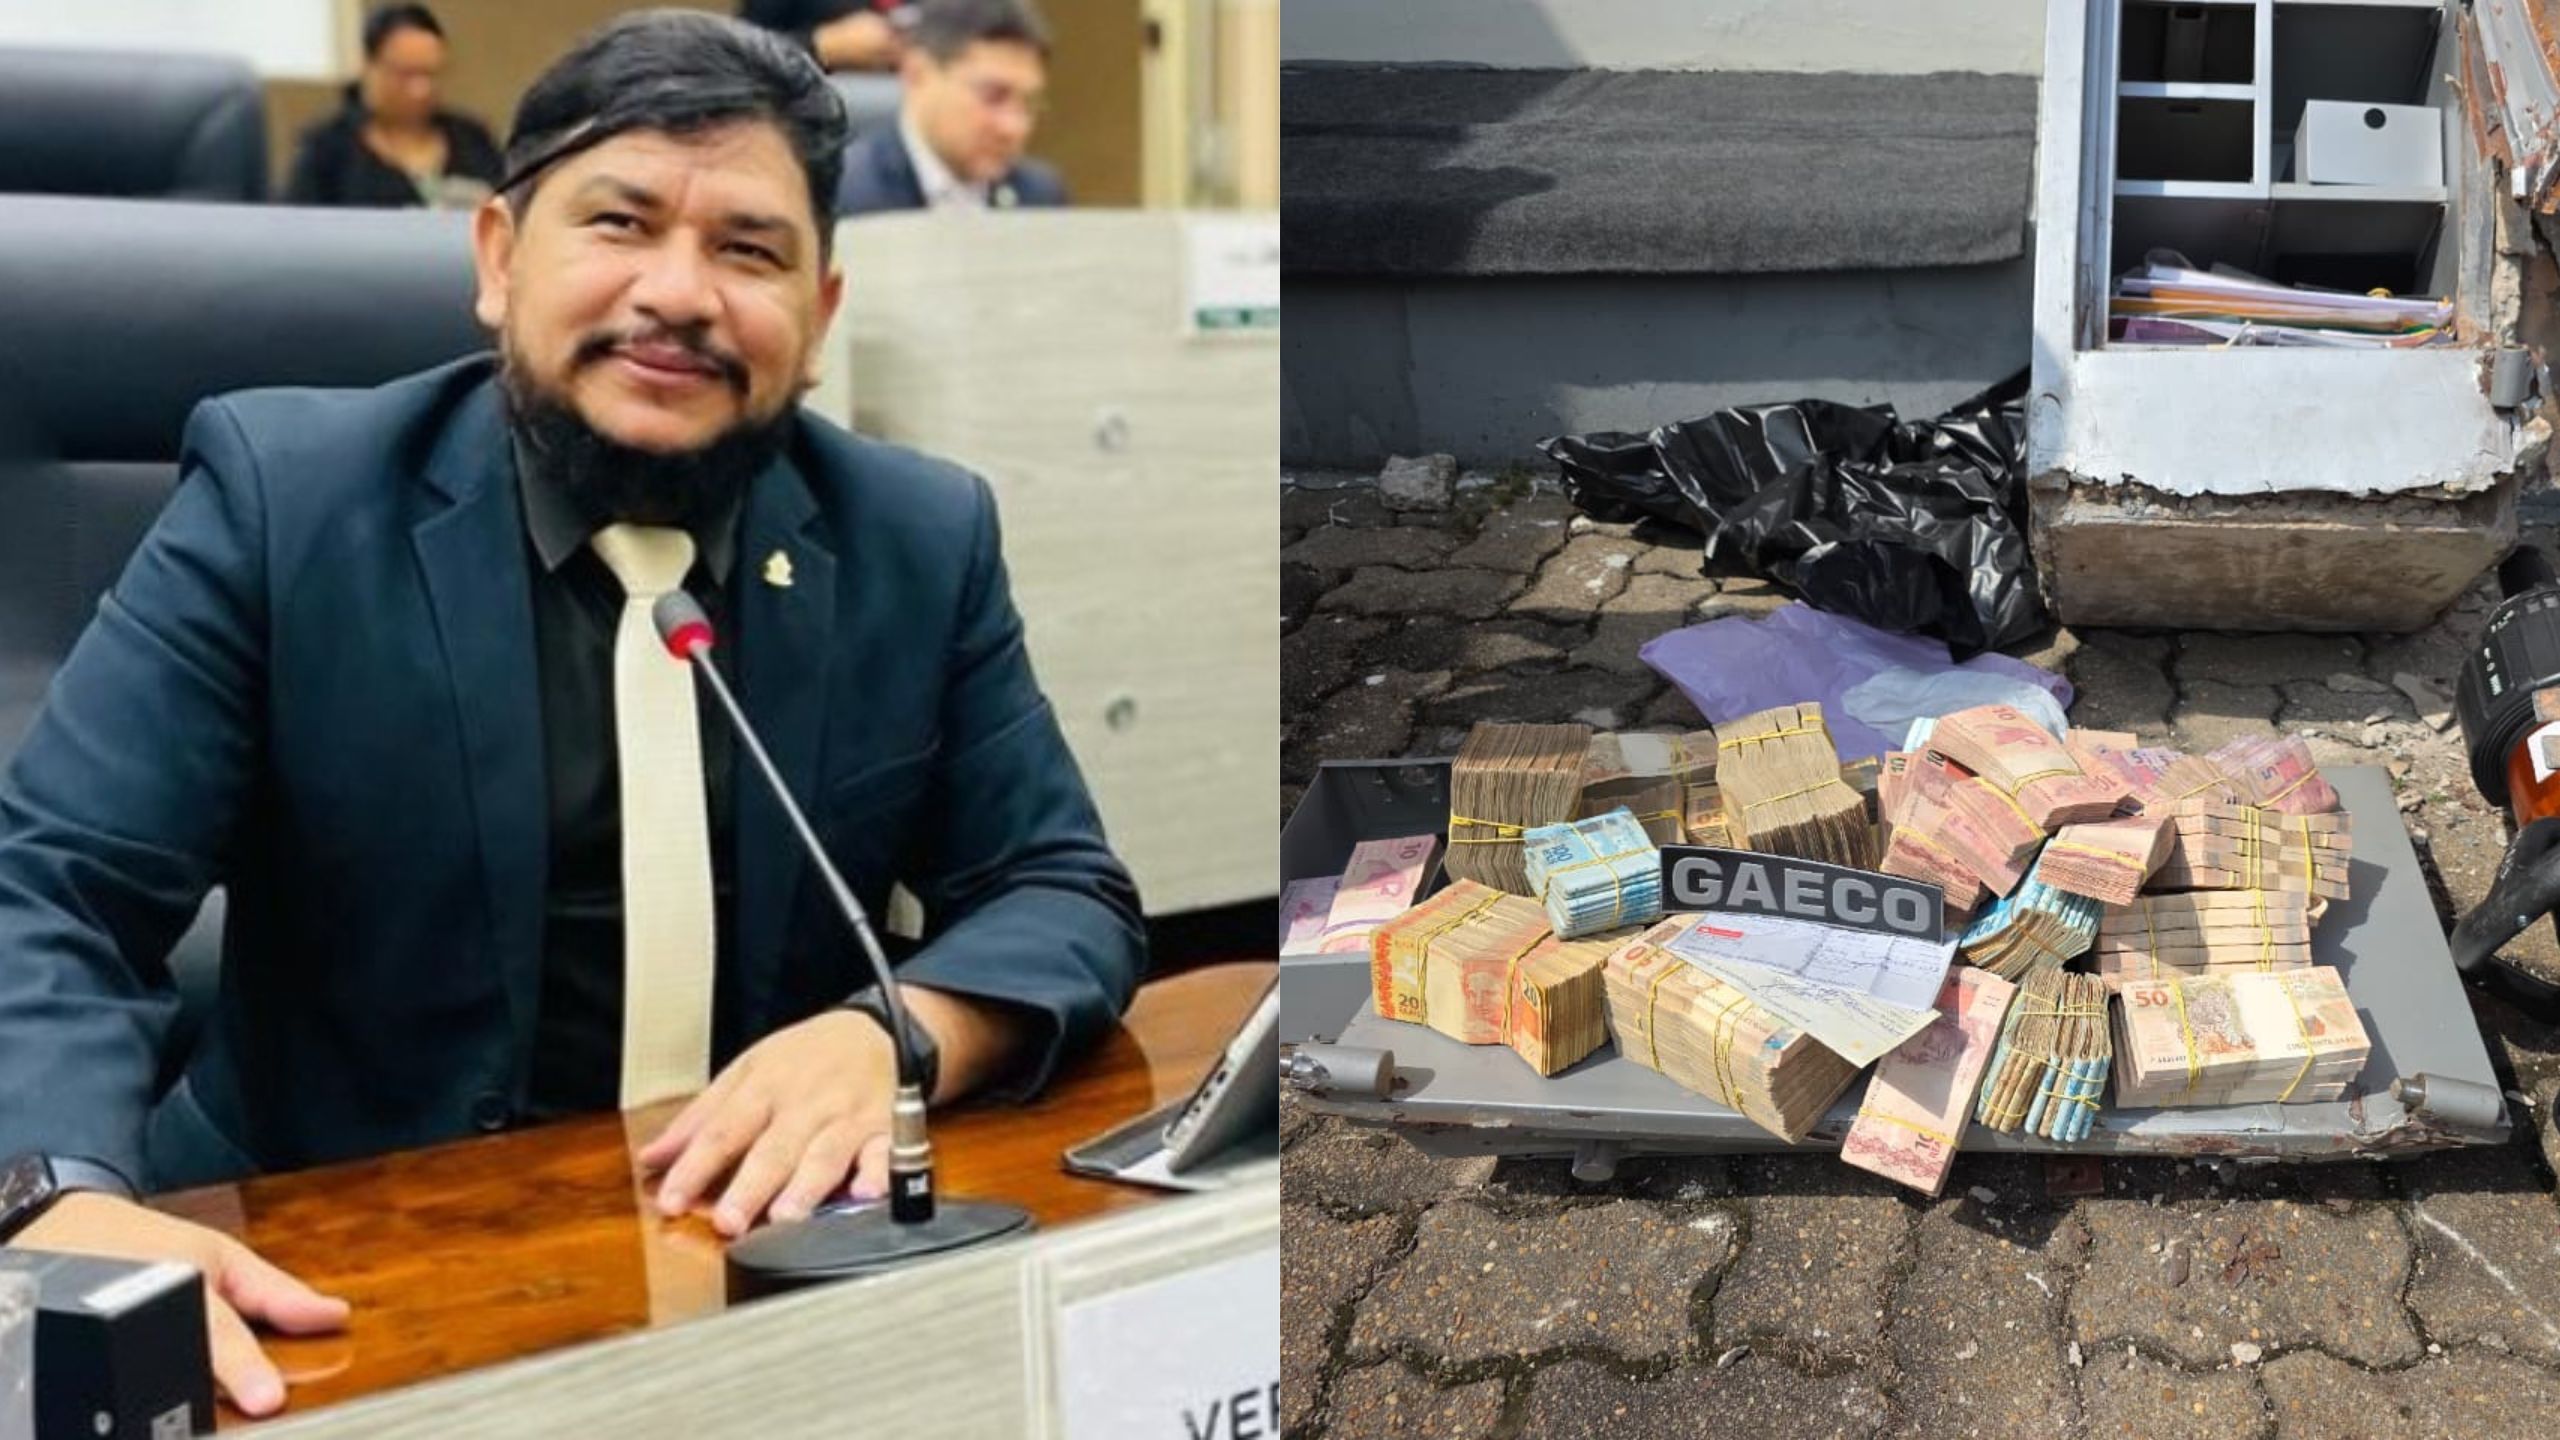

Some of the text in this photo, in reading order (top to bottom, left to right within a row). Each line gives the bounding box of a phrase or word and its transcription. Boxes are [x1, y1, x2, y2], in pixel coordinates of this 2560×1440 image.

[1890, 757, 1906, 773] 10
[1927, 750, 1946, 768] 10
[2261, 765, 2278, 781] 5
[1400, 842, 1422, 860] 10
[1672, 857, 1932, 933] GAECO
[1399, 992, 1420, 1010] 20
[2135, 989, 2169, 1008] 50
